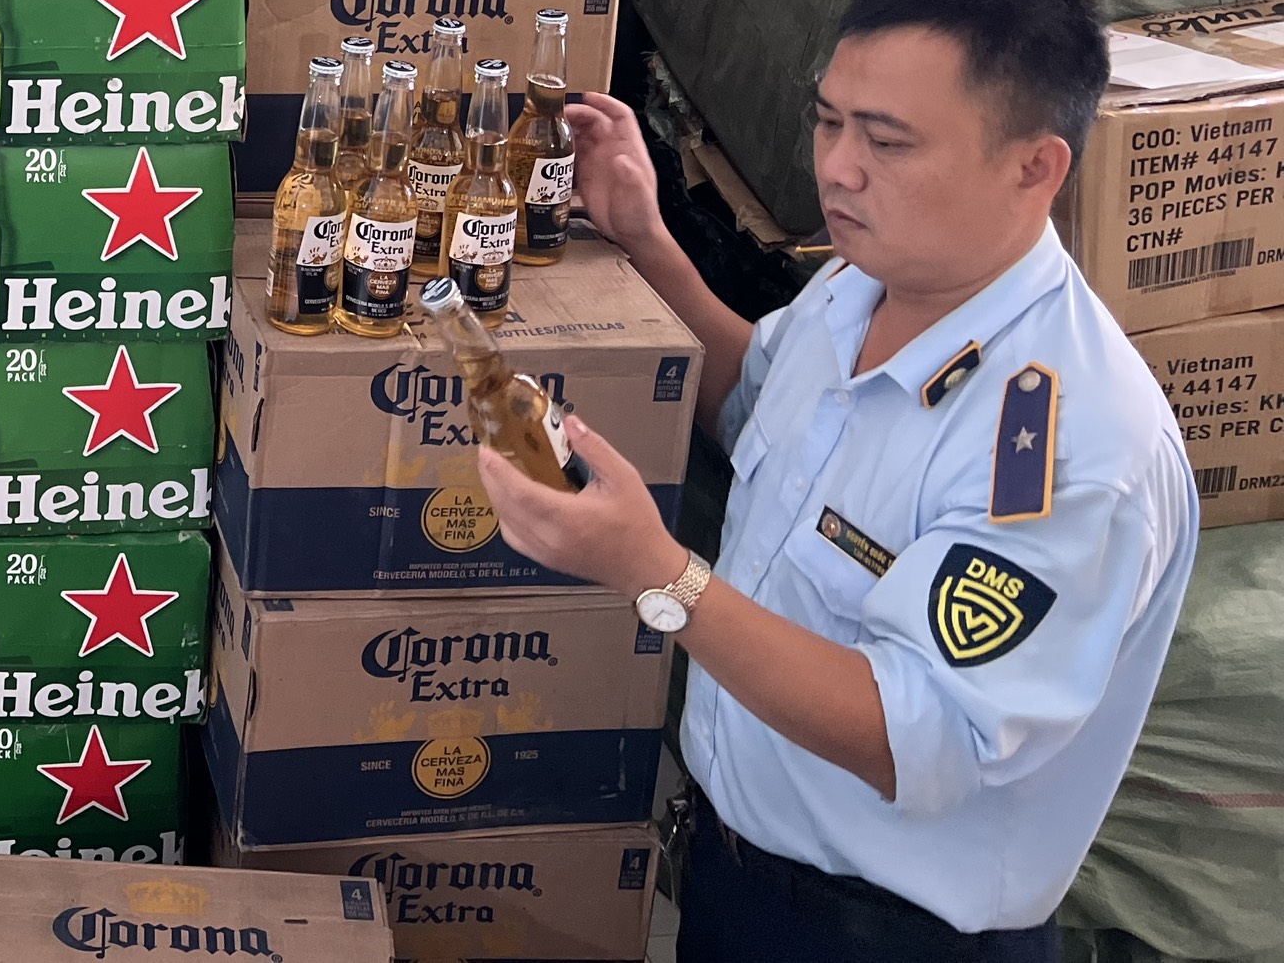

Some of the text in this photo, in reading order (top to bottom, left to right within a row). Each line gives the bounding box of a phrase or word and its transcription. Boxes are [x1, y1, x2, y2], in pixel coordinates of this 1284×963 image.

[377, 22, 469, 54] Ext
[6, 76, 245, 134] Heinek
[1132, 118, 1272, 150] COO: Vietnam
[25, 149, 56, 171] 20
[1130, 138, 1278, 177] ITEM# 44147
[26, 173, 55, 183] PACK
[415, 183, 446, 196] Extra
[1130, 167, 1266, 203] POP Movies:
[1129, 187, 1274, 226] 36 PIECES PER
[356, 221, 413, 244] Corona
[480, 237, 509, 248] Extra
[1127, 227, 1183, 252] CTN#
[371, 242, 403, 255] Extra
[2, 276, 232, 330] Heinek
[6, 349, 36, 371] 20
[1167, 356, 1253, 375] Vietnam
[7, 372, 35, 382] PACK
[666, 365, 677, 377] 4
[1182, 374, 1257, 395] 44147
[1220, 420, 1260, 438] PER
[453, 495, 473, 507] LA
[369, 506, 401, 519] SINCE
[430, 506, 494, 519] CERVEZA
[446, 518, 477, 529] MAS
[444, 529, 476, 542] FINA
[7, 554, 37, 574] 20
[8, 575, 35, 585] PACK
[373, 570, 426, 580] CERVECERIA
[479, 569, 490, 577] DE
[966, 558, 1025, 599] DMS
[361, 627, 552, 683] Corona
[410, 669, 509, 704] Extra
[444, 746, 461, 755] LA
[515, 750, 539, 760] 1925
[361, 760, 392, 771] SINCE
[421, 755, 482, 768] CERVEZA
[436, 767, 465, 777] MAS
[434, 778, 464, 787] FINA
[366, 817, 418, 828] CERVECERIA
[629, 857, 640, 868] 4
[351, 888, 362, 901] 4
[396, 894, 495, 924] Extra
[52, 906, 274, 959] Corona
